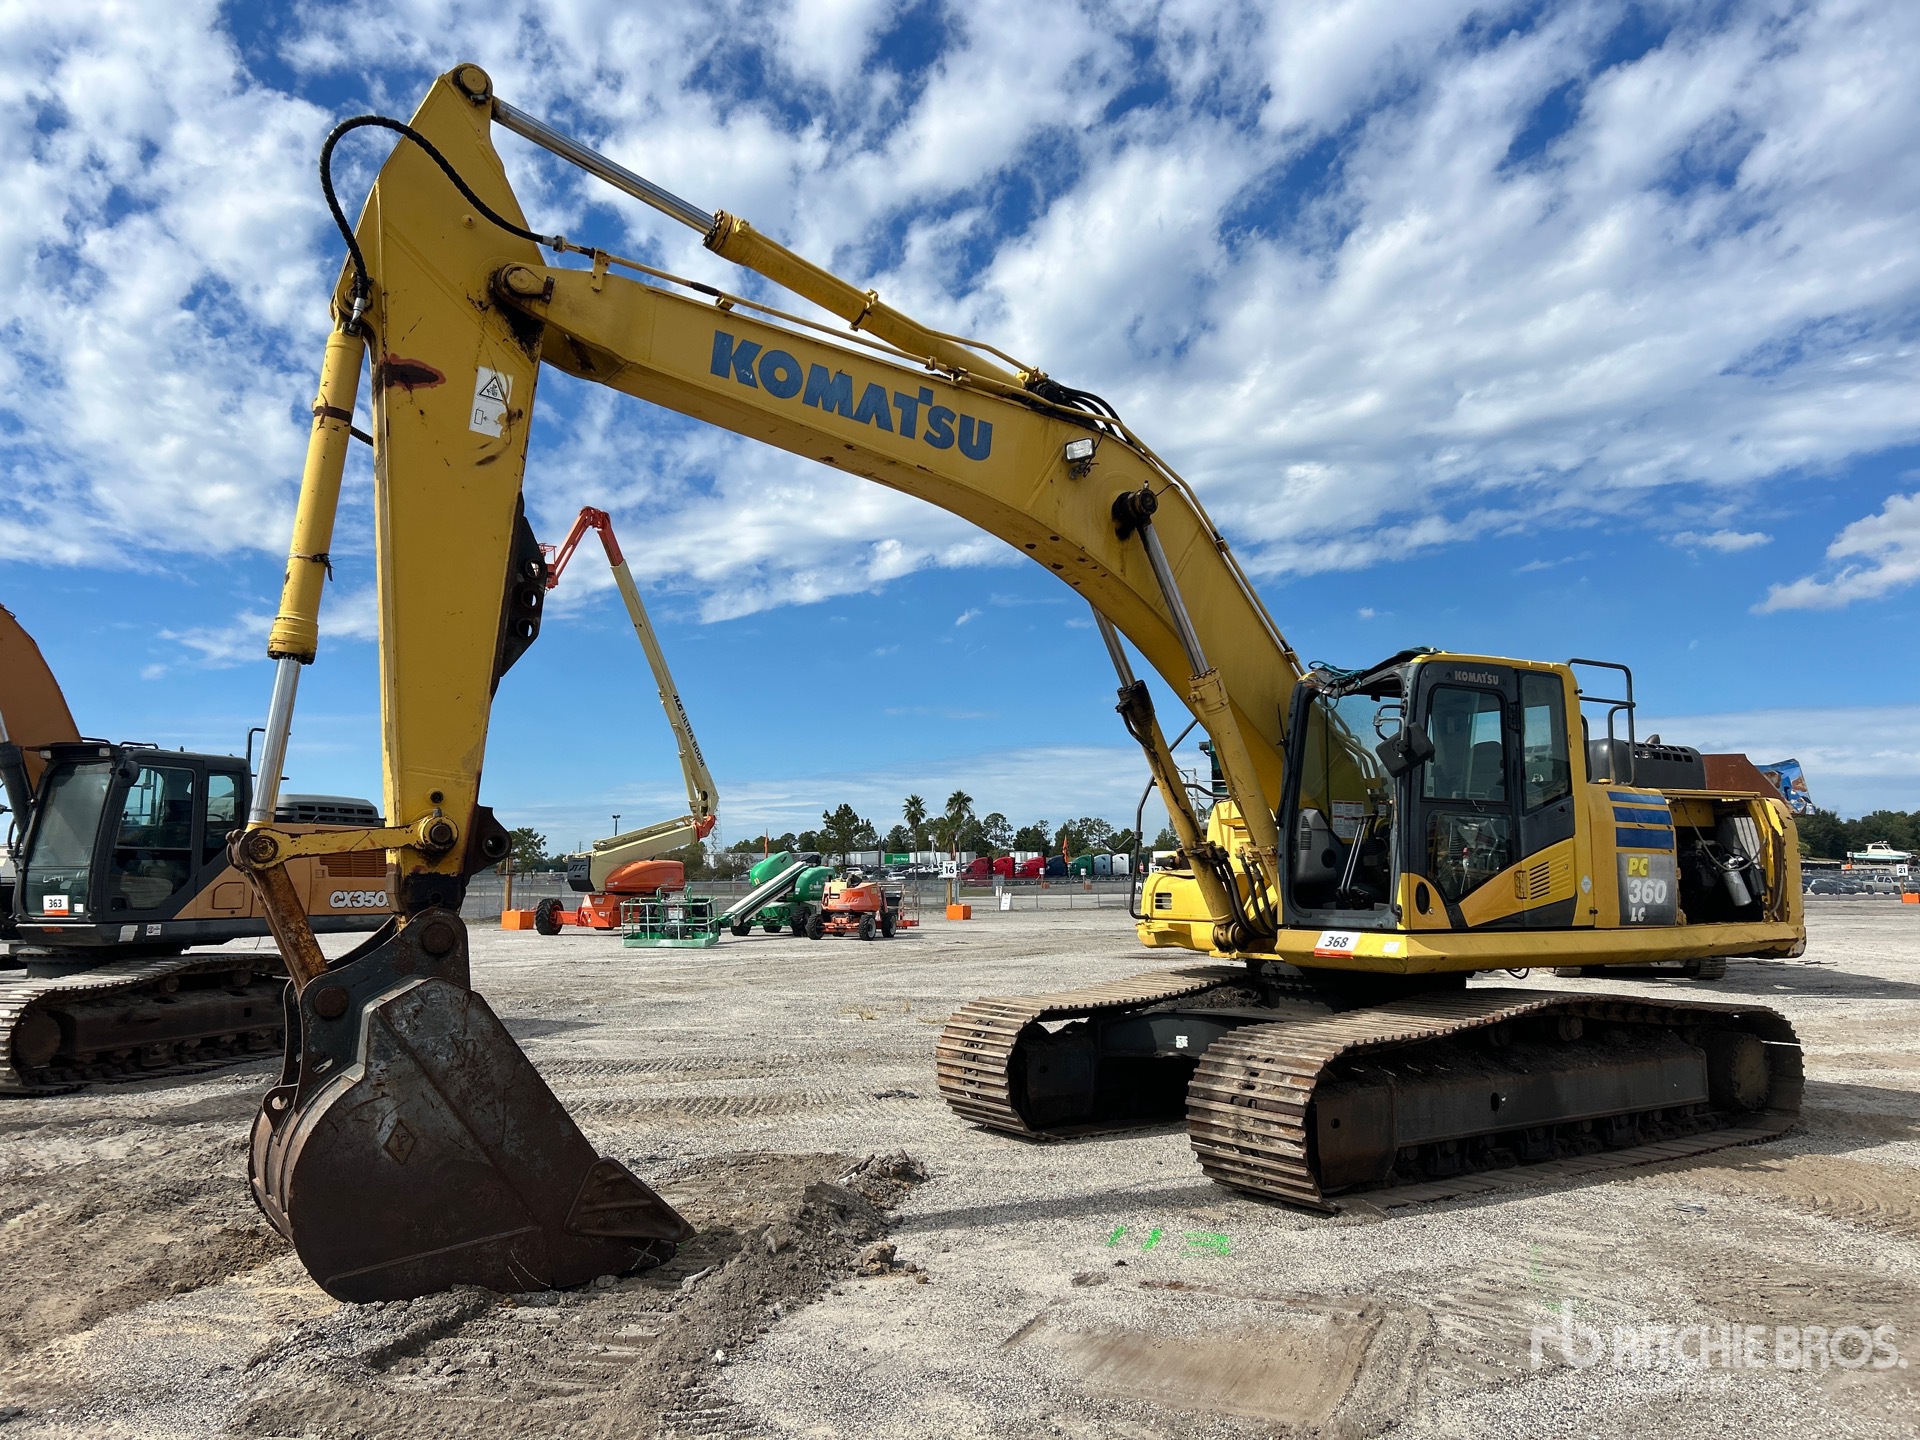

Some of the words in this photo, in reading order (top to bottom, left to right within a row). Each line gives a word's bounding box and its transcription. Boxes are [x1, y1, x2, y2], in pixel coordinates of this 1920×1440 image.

[710, 329, 993, 461] KOMATSU
[1454, 670, 1500, 686] KOMATSU
[673, 694, 684, 711] JLG
[681, 712, 694, 741] ULTRA
[691, 741, 705, 768] BOOM
[944, 865, 955, 874] 16
[1628, 857, 1649, 876] PC
[329, 890, 389, 908] CX350
[1628, 879, 1667, 904] 360
[48, 898, 63, 908] 363
[1630, 906, 1646, 922] LC
[1324, 936, 1349, 948] 368
